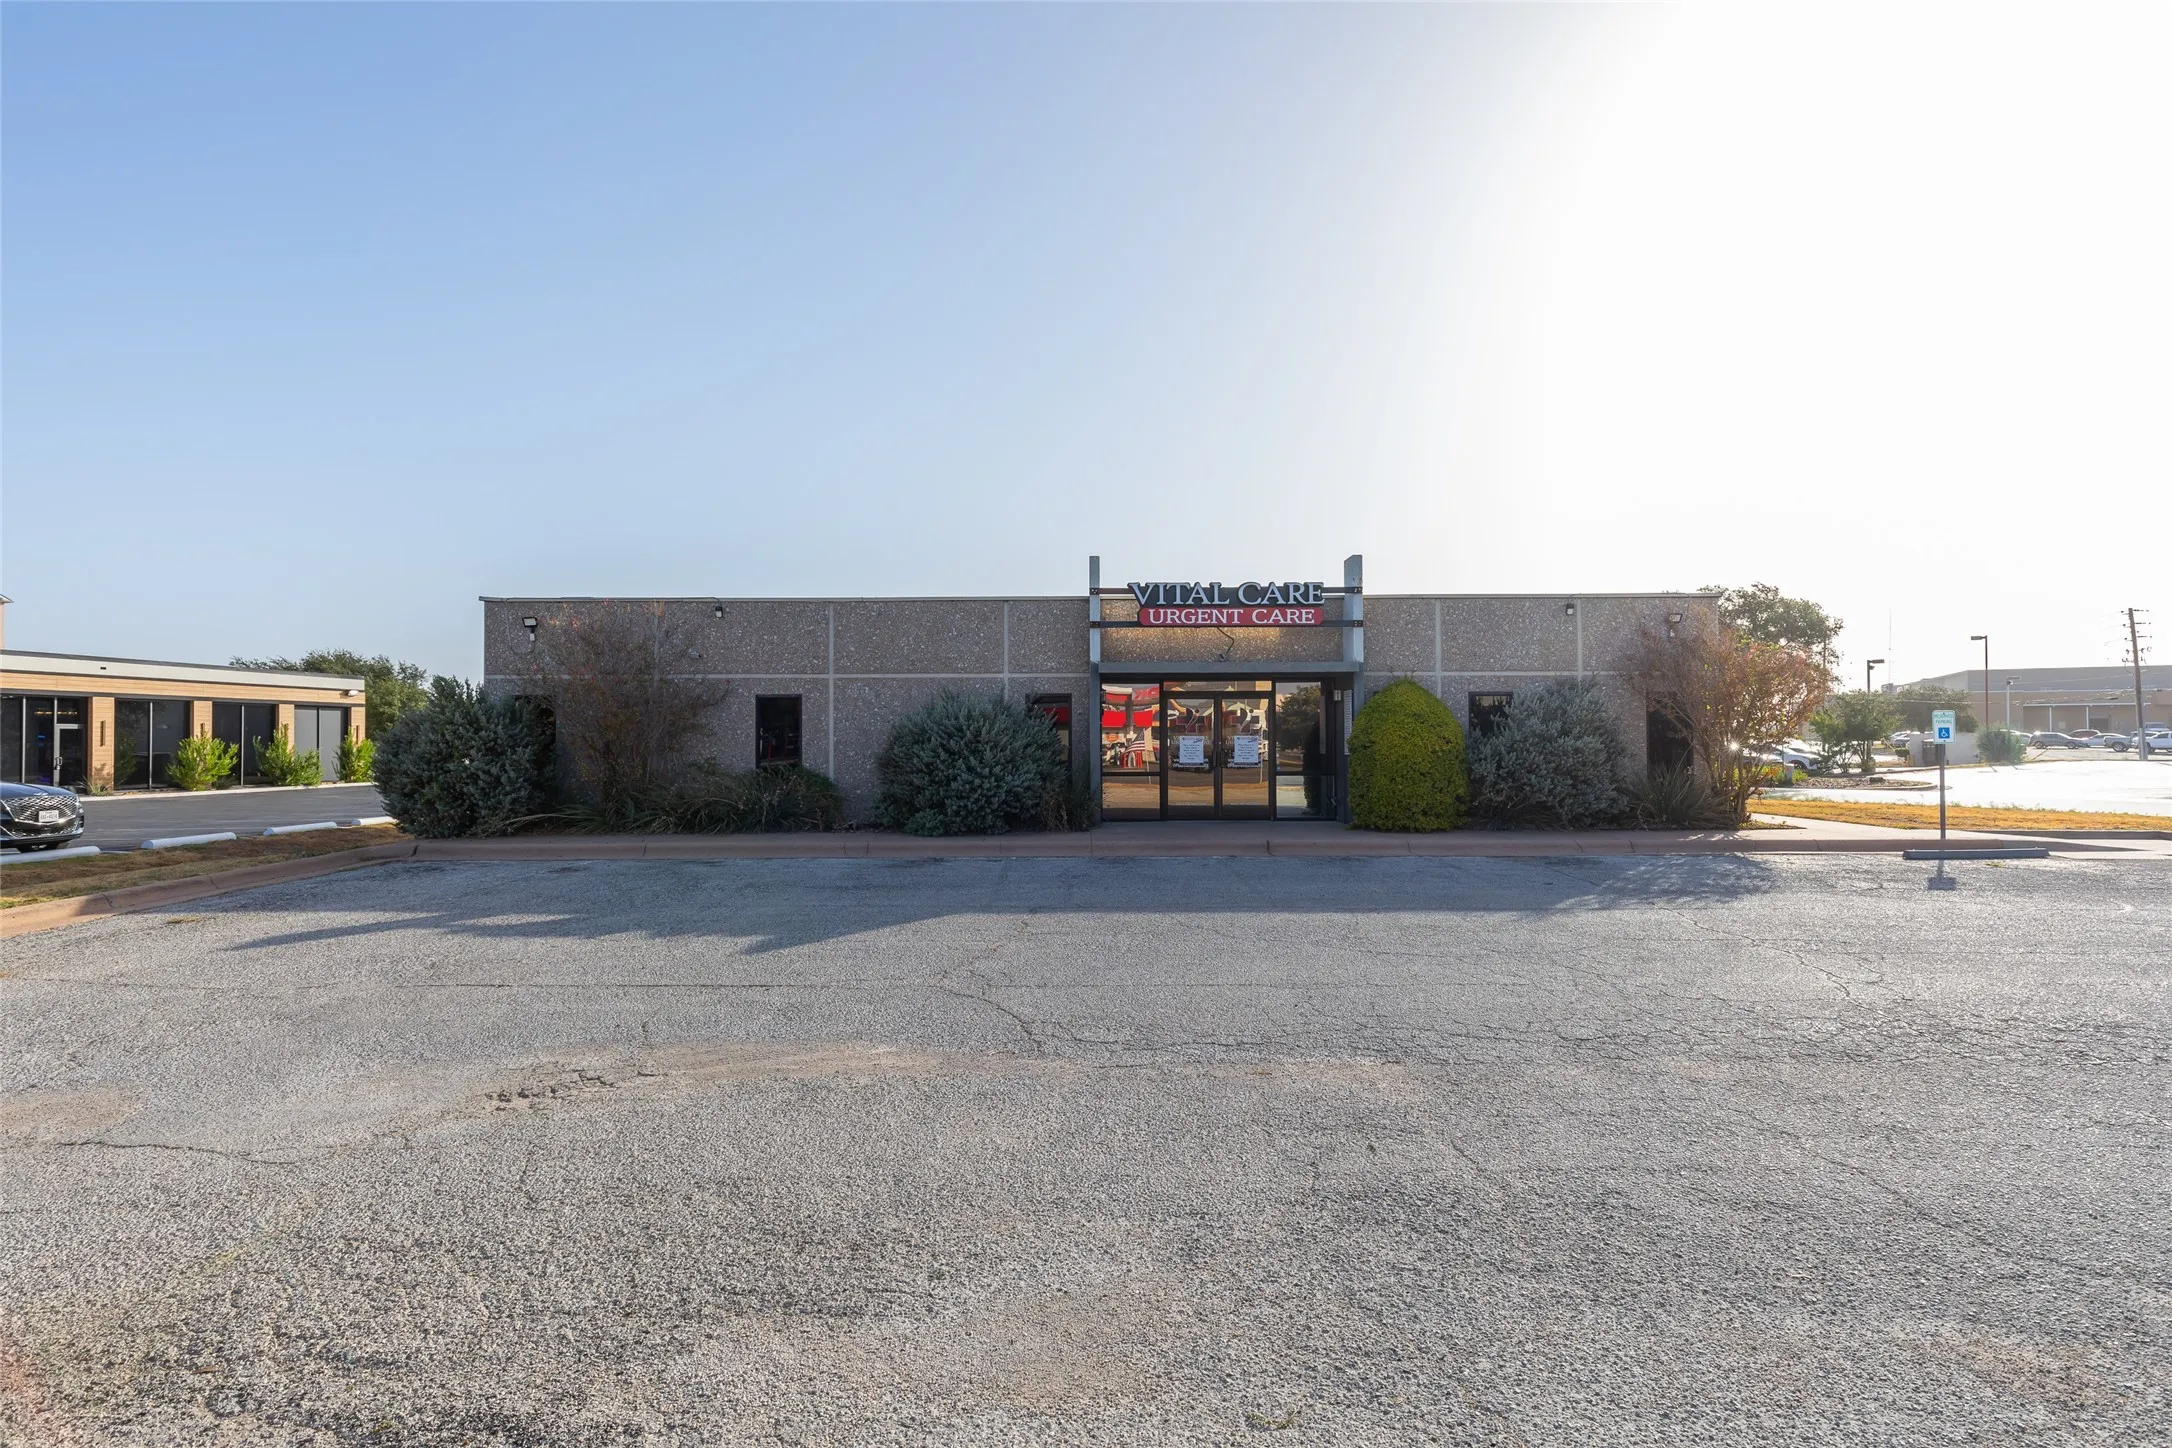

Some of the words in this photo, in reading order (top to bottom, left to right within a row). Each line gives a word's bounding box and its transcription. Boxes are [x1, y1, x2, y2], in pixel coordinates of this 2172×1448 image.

[1128, 582, 1230, 606] VITAL
[1238, 582, 1325, 606] CARE
[1148, 609, 1244, 624] URGENT
[1252, 609, 1315, 624] CARE
